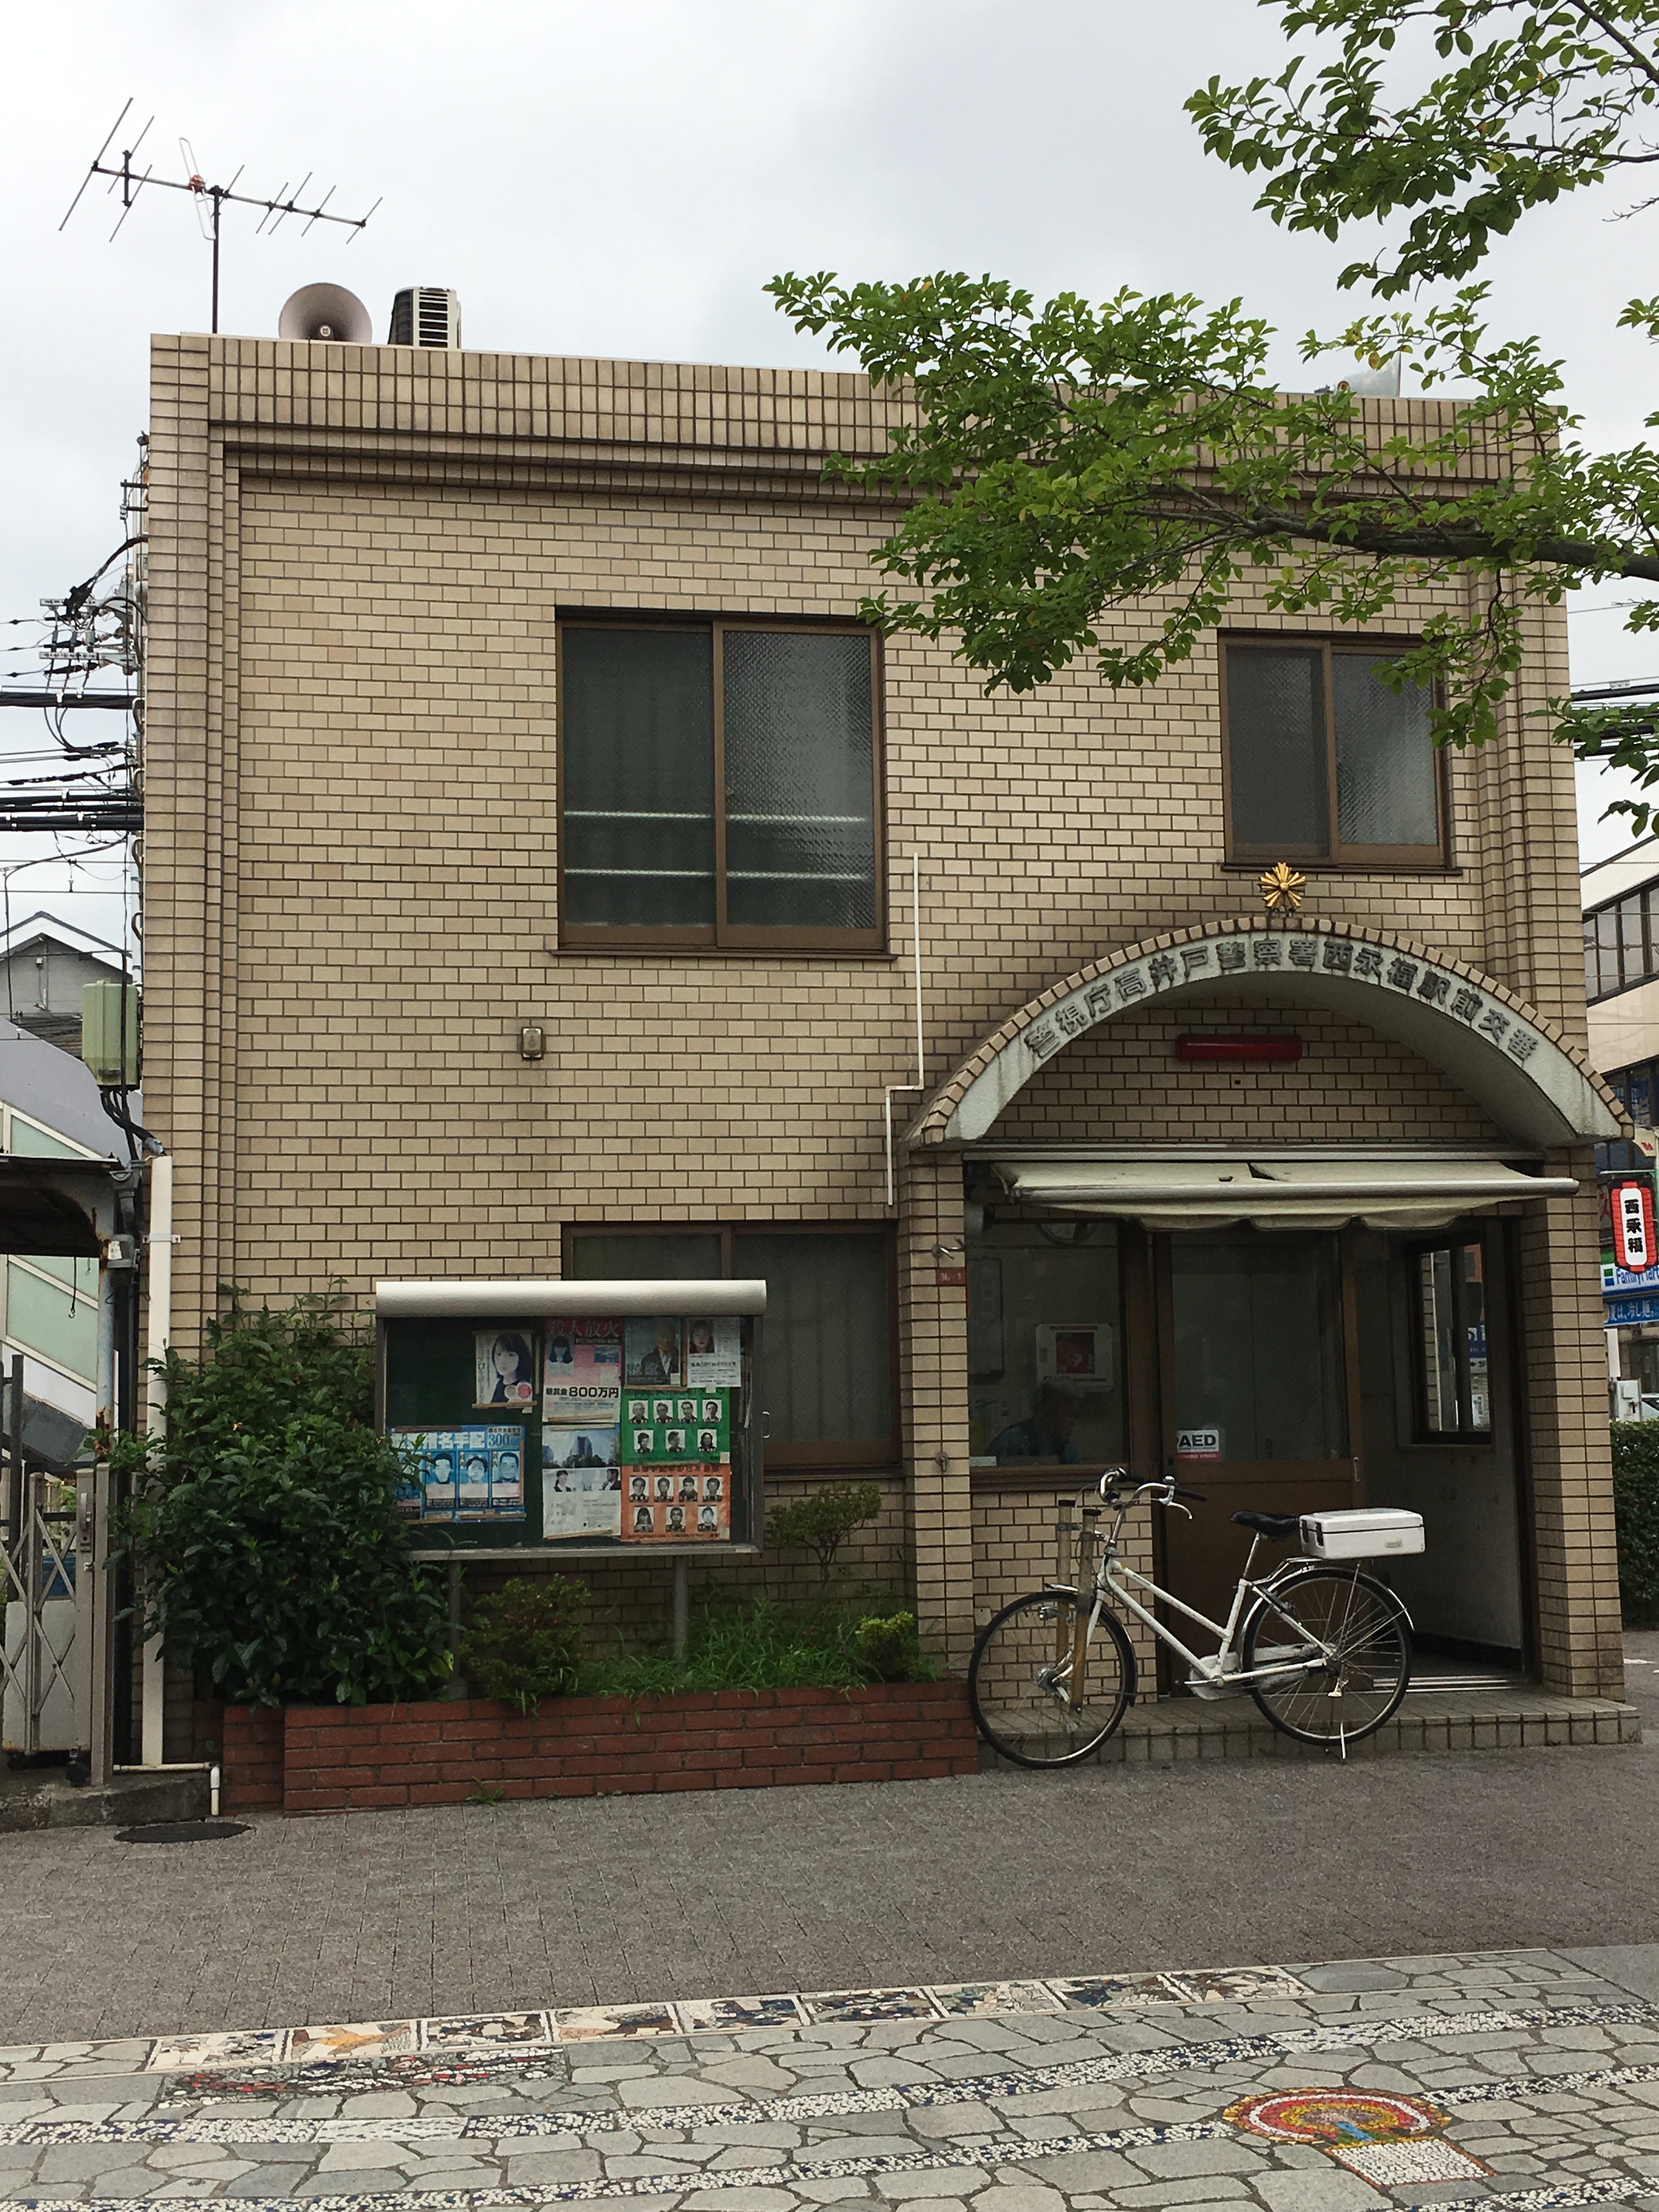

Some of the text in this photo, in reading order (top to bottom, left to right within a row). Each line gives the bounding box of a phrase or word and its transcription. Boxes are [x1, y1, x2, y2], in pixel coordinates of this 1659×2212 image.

[1024, 938, 1538, 1061] 警視庁高井戸警察署西永福駅前交番
[1624, 1199, 1644, 1254] 西永福
[1178, 1434, 1217, 1447] AED
